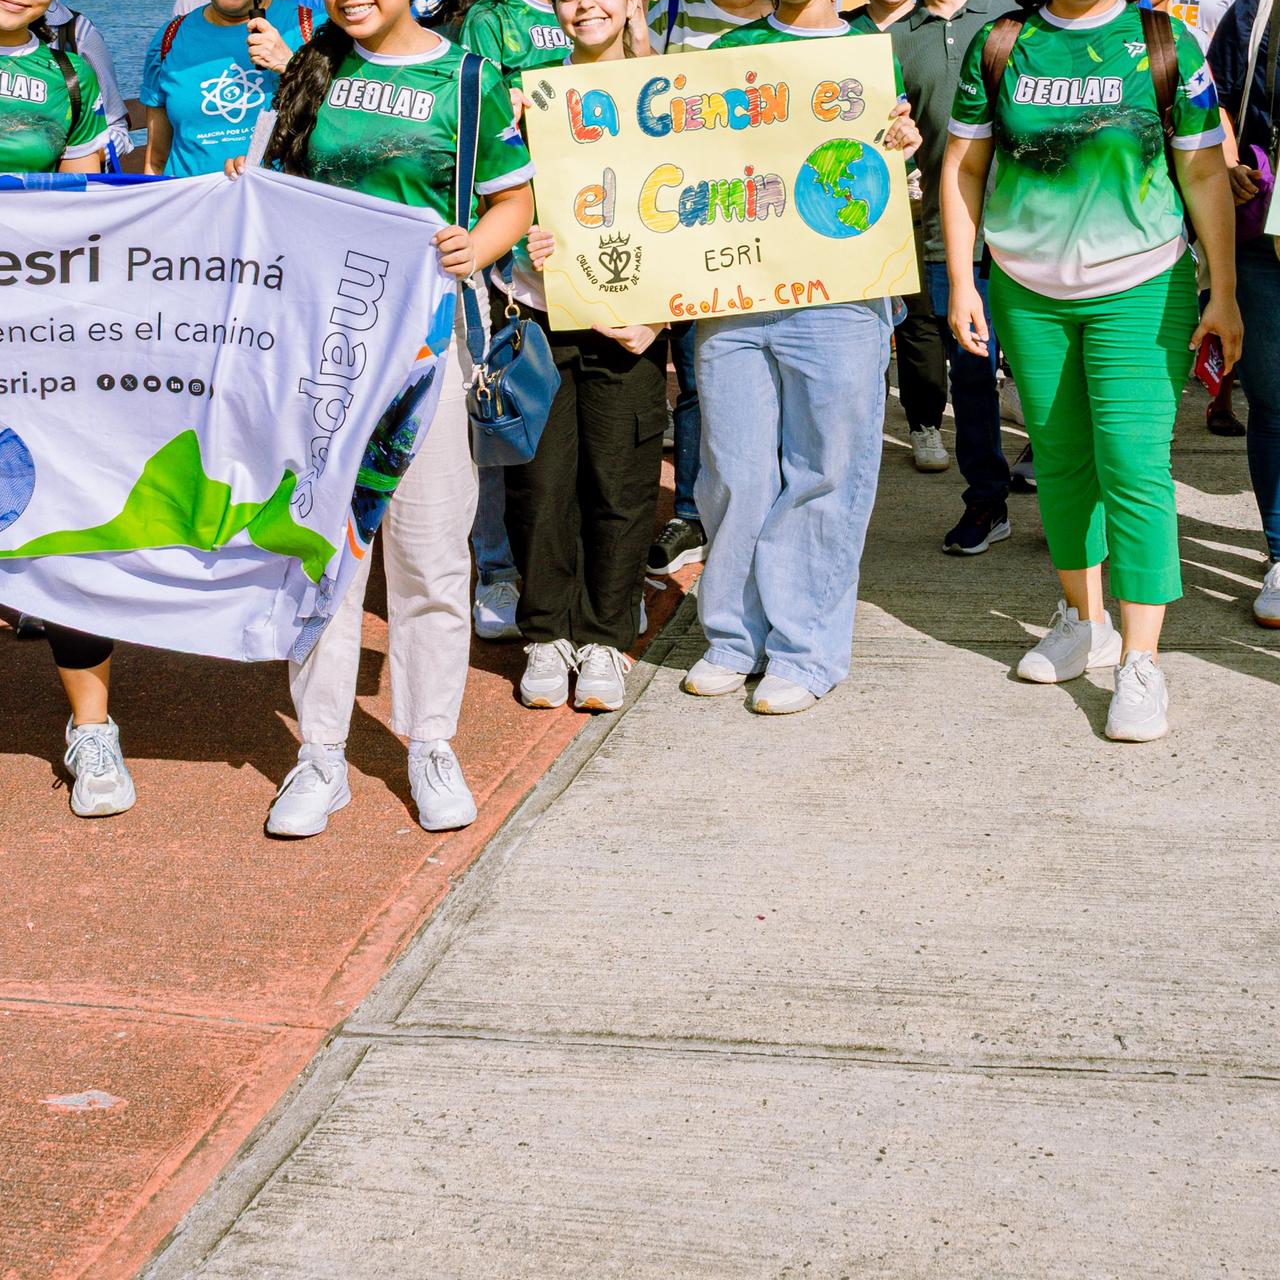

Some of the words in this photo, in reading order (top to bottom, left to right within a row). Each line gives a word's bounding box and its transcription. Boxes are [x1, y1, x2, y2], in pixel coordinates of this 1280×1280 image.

[328, 77, 435, 122] GEOLAB
[1013, 74, 1123, 106] GEOLAB
[127, 246, 285, 290] Panamá
[576, 254, 599, 285] COLEGIO
[599, 284, 629, 293] PUREZA
[630, 274, 640, 285] DE
[88, 321, 123, 342] es
[135, 312, 162, 342] el
